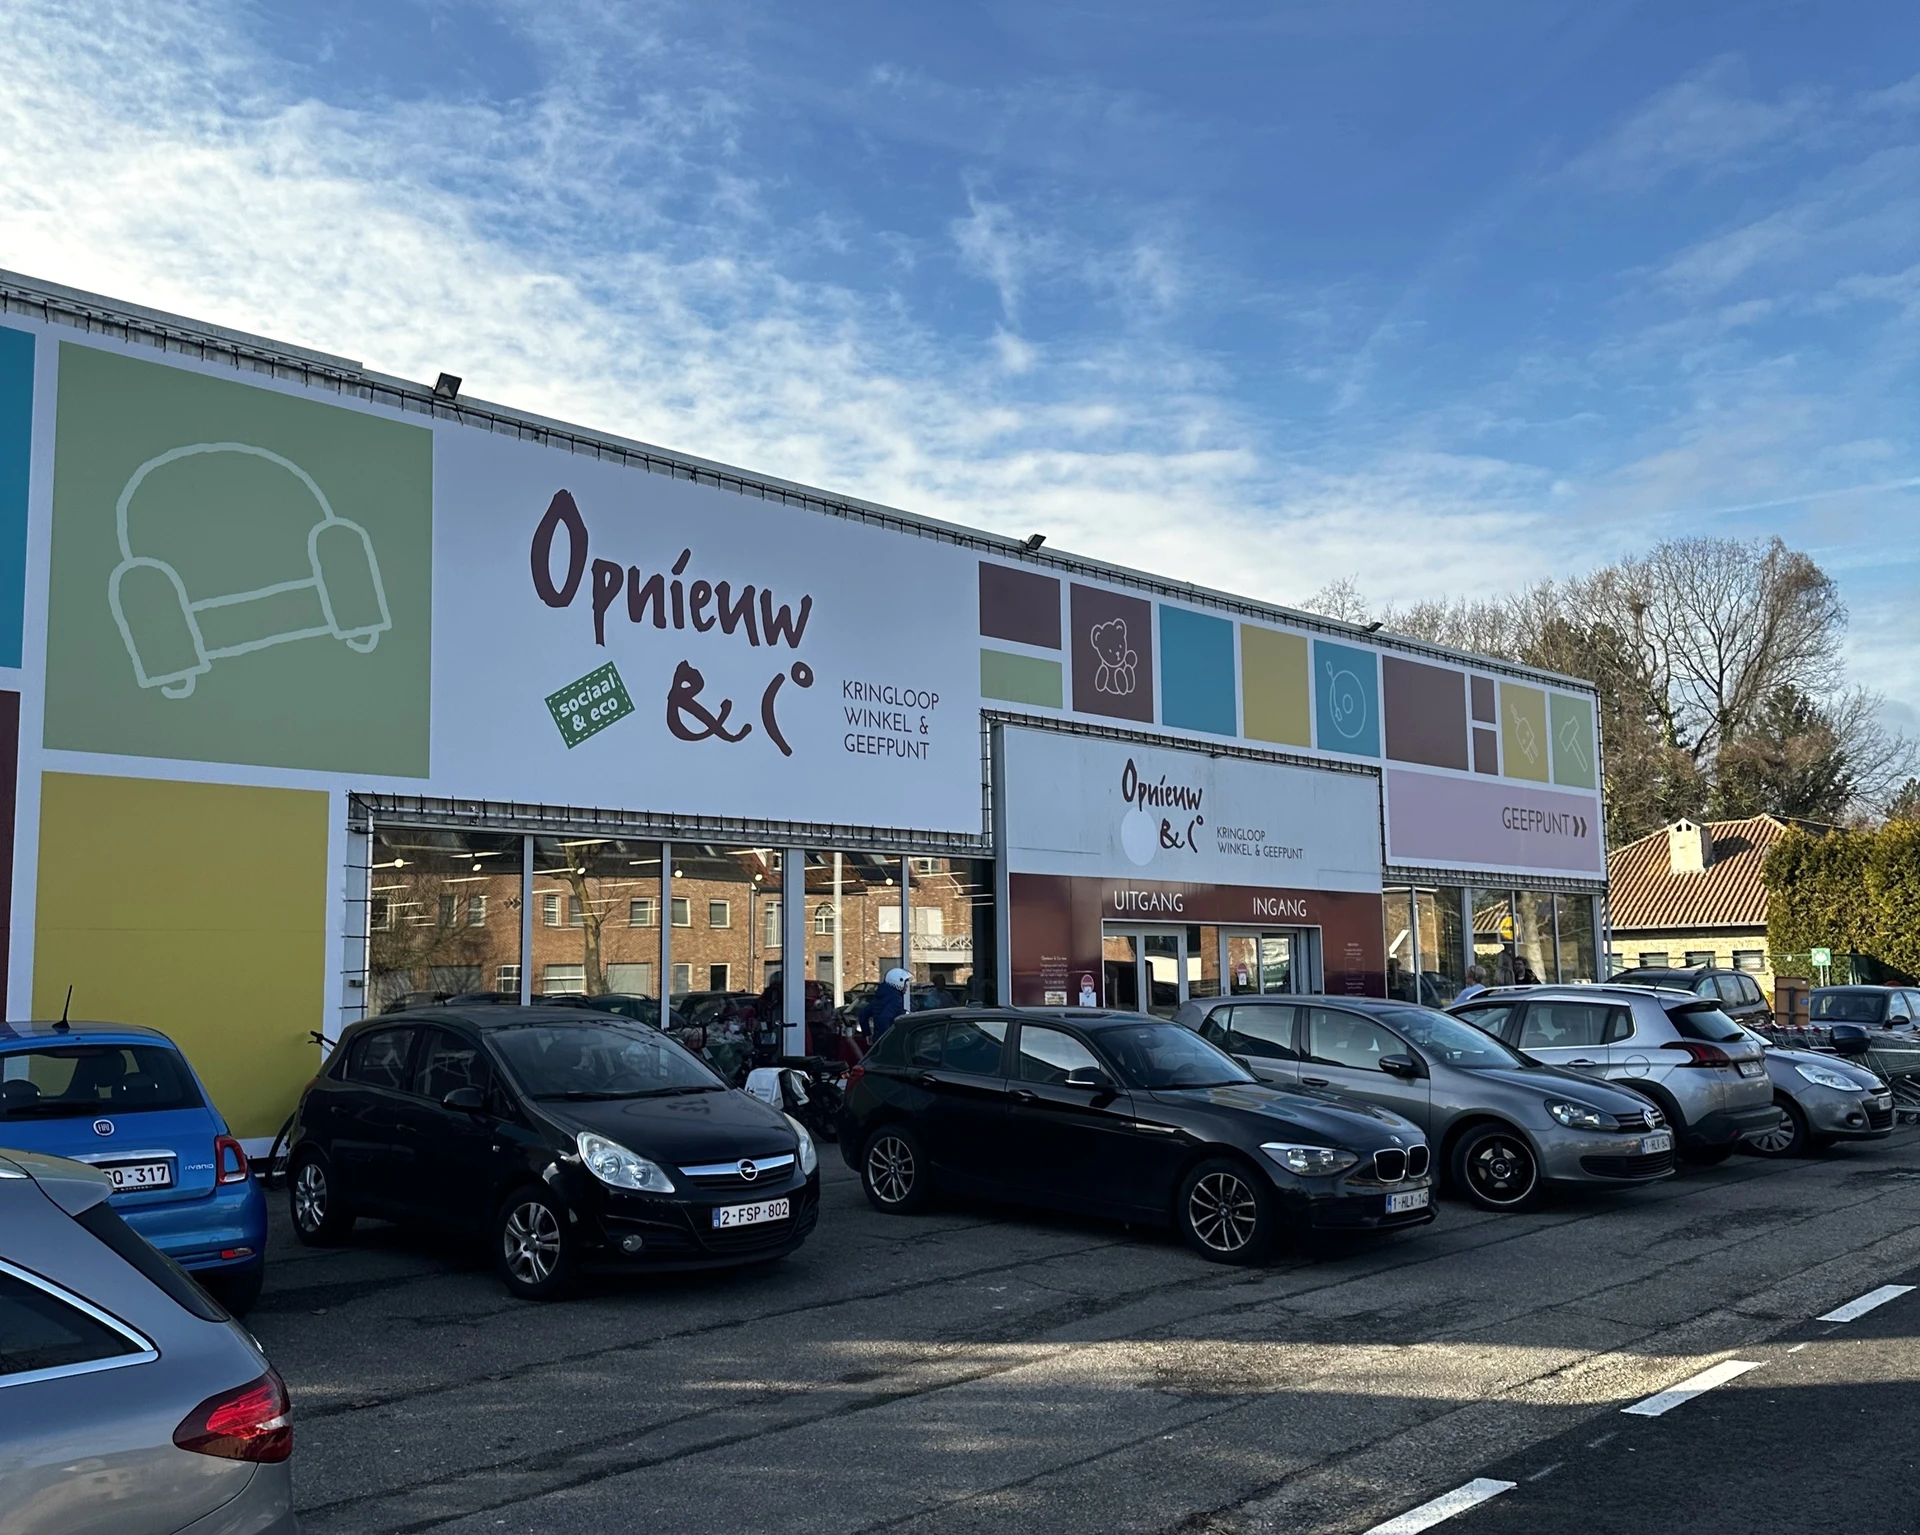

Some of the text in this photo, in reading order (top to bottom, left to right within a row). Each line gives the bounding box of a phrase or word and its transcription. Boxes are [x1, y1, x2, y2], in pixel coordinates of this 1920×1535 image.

[559, 672, 616, 718] sociaal
[667, 660, 752, 742] &
[843, 680, 939, 710] KRINGLOOP
[572, 697, 618, 731] & eco
[844, 706, 929, 735] WINKEL &
[844, 733, 930, 760] GEEFPUNT
[1160, 818, 1185, 849] &
[1216, 826, 1266, 842] KRINGLOOP
[1502, 806, 1570, 836] GEEFPUNT
[1217, 841, 1303, 860] WINKEL & GEEFPUNT
[1114, 890, 1184, 912] UITGANG
[1253, 897, 1307, 917] INGANG
